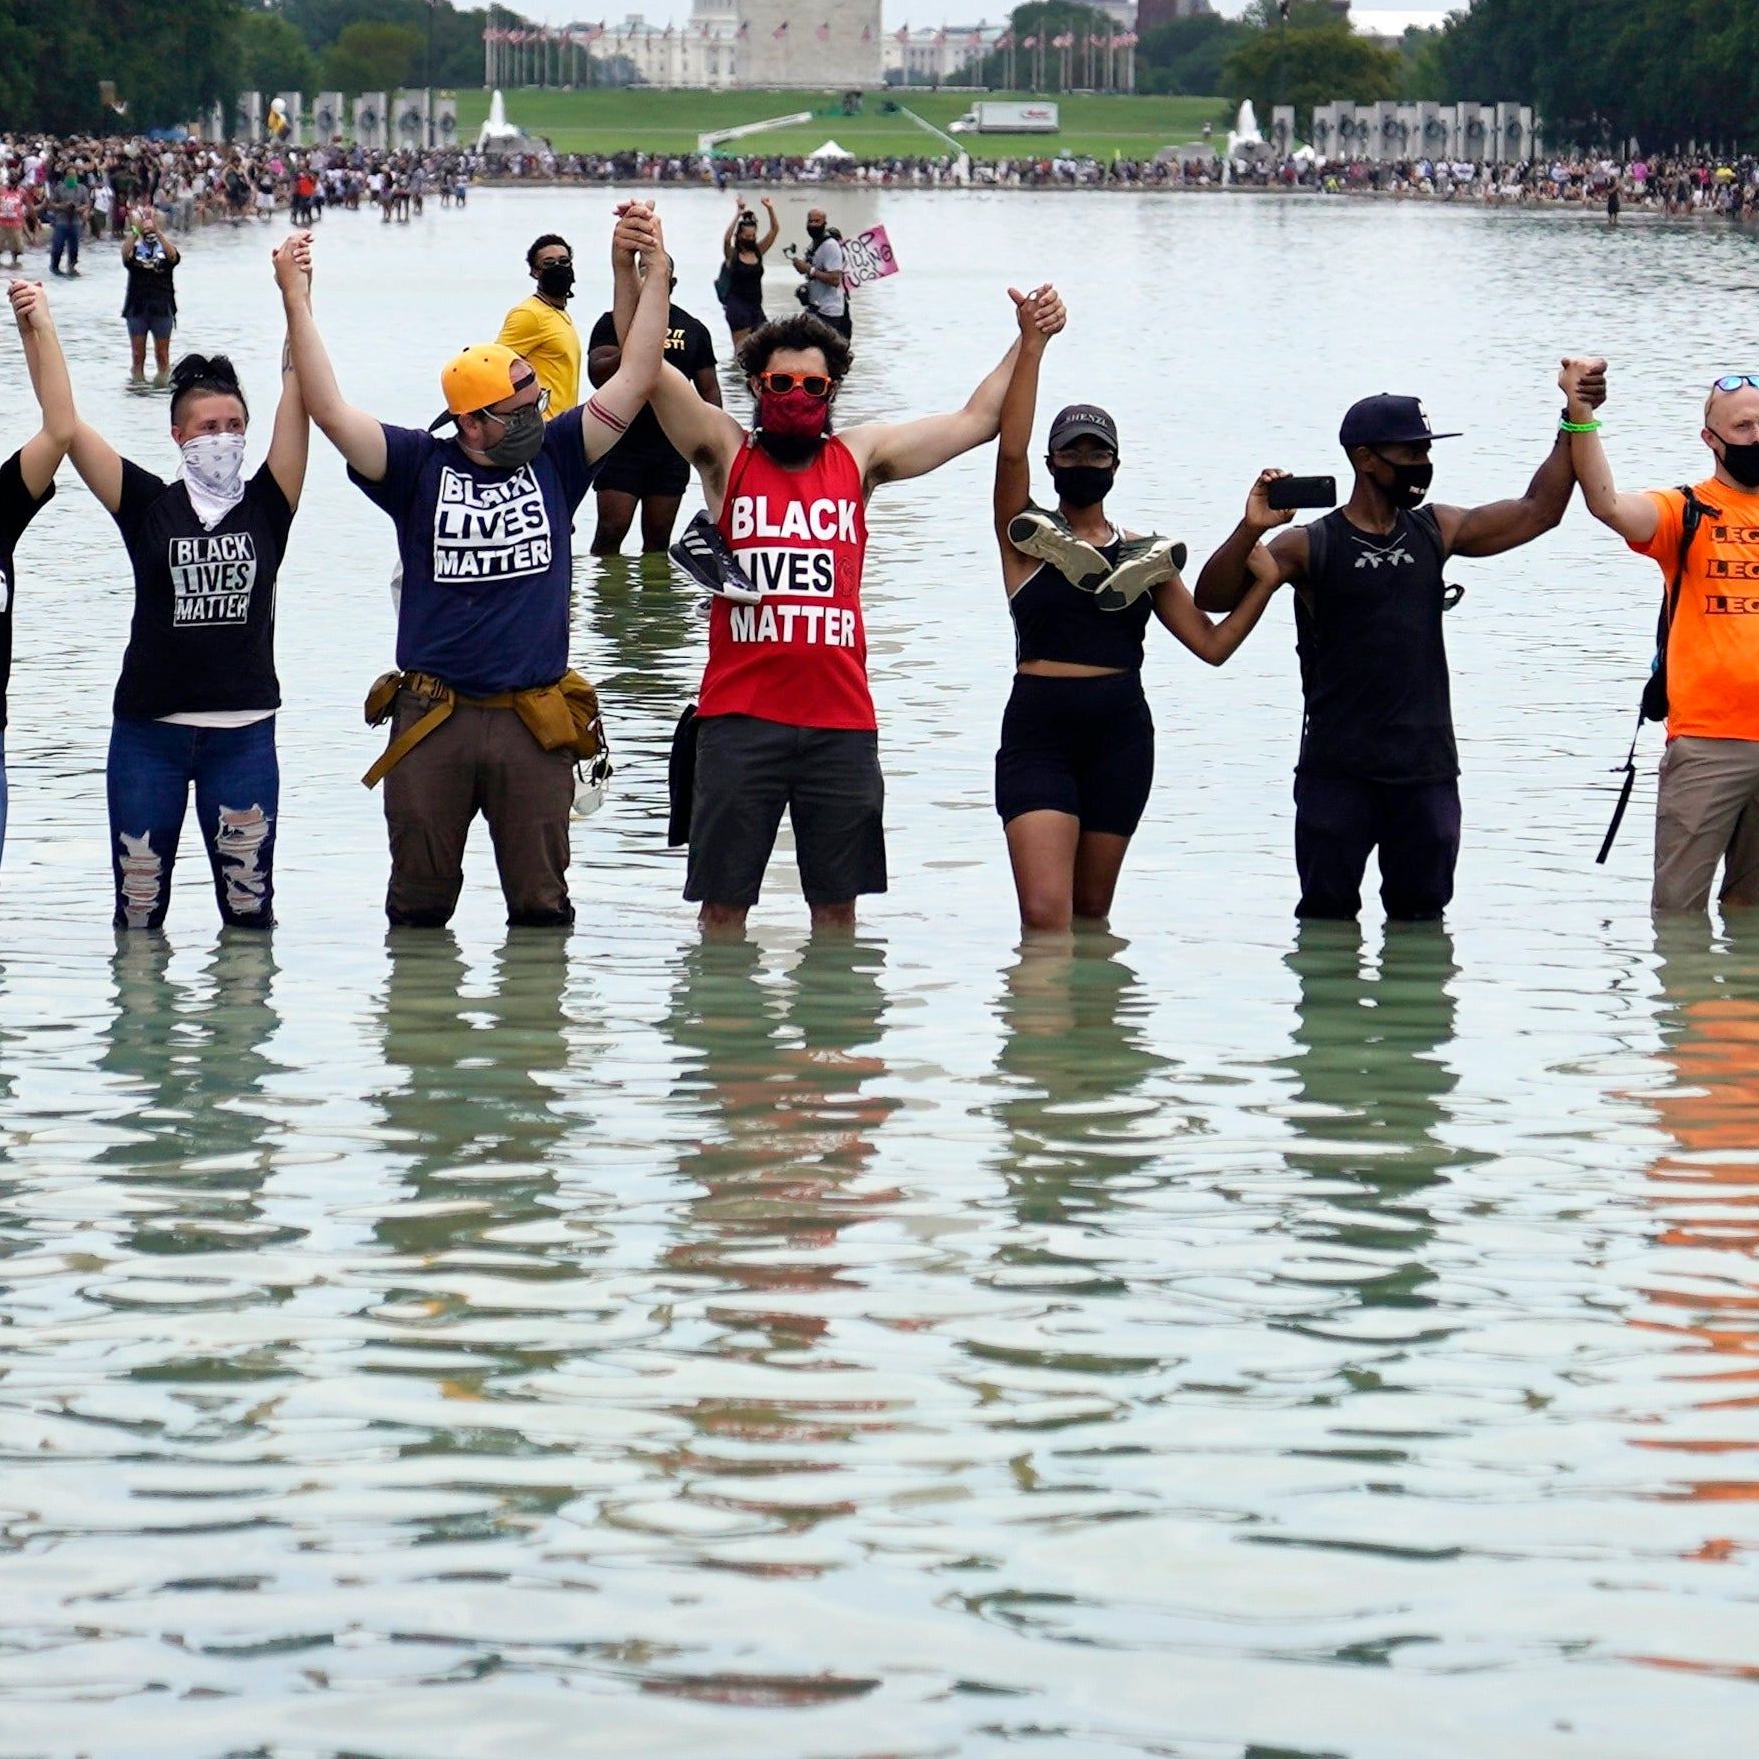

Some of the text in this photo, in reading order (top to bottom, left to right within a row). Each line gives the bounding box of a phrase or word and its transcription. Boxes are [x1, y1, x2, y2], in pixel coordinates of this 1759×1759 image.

[438, 500, 544, 539] LIVES
[731, 495, 858, 545] BLACK
[177, 535, 251, 565] BLACK
[437, 540, 550, 576] MATTER
[182, 563, 250, 594] LIVES
[734, 552, 833, 592] IVES
[176, 594, 247, 621] MATTER
[730, 604, 856, 648] MATTER
